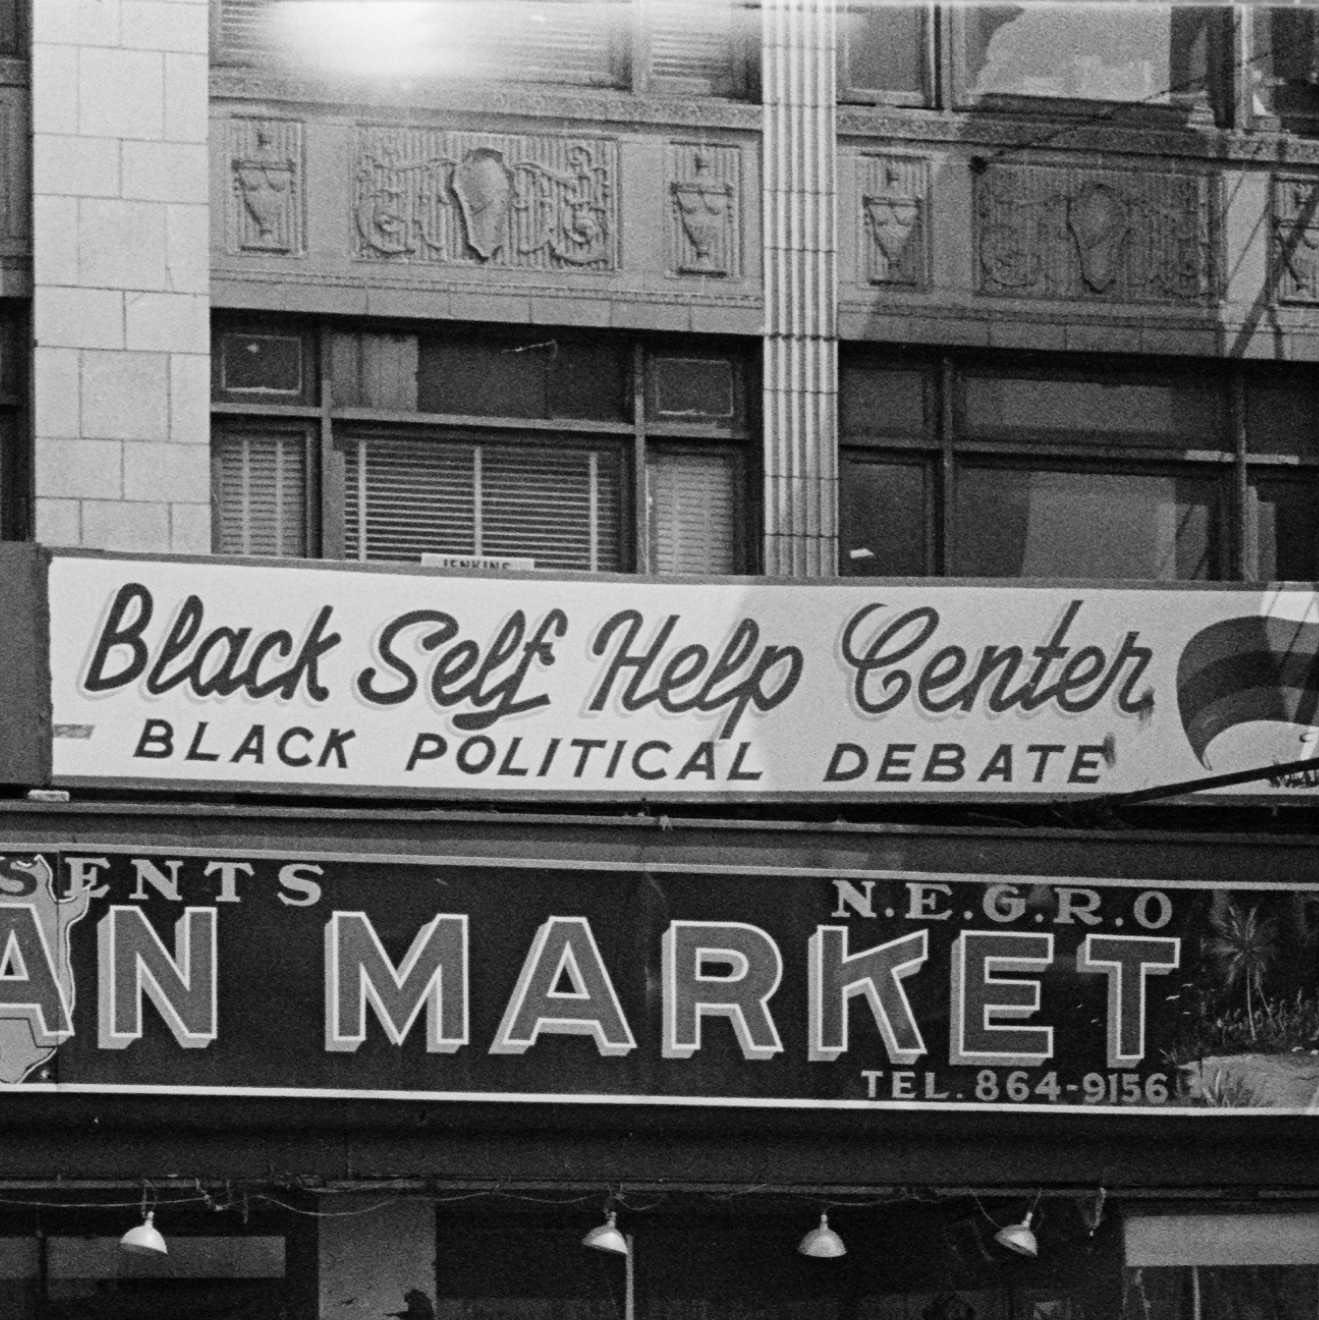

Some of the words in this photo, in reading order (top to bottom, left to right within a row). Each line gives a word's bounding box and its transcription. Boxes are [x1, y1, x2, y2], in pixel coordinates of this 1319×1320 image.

[83, 583, 340, 701] Black
[357, 608, 568, 731] Self
[592, 608, 804, 739] Help
[840, 600, 1155, 716] Center
[133, 719, 356, 770] BLACK
[405, 732, 764, 782] POLITICAL
[823, 742, 1110, 784] DEBATE
[324, 910, 1181, 1069] MARKET
[861, 1069, 963, 1101] TEL.
[975, 1069, 1169, 1103] 864-9156
